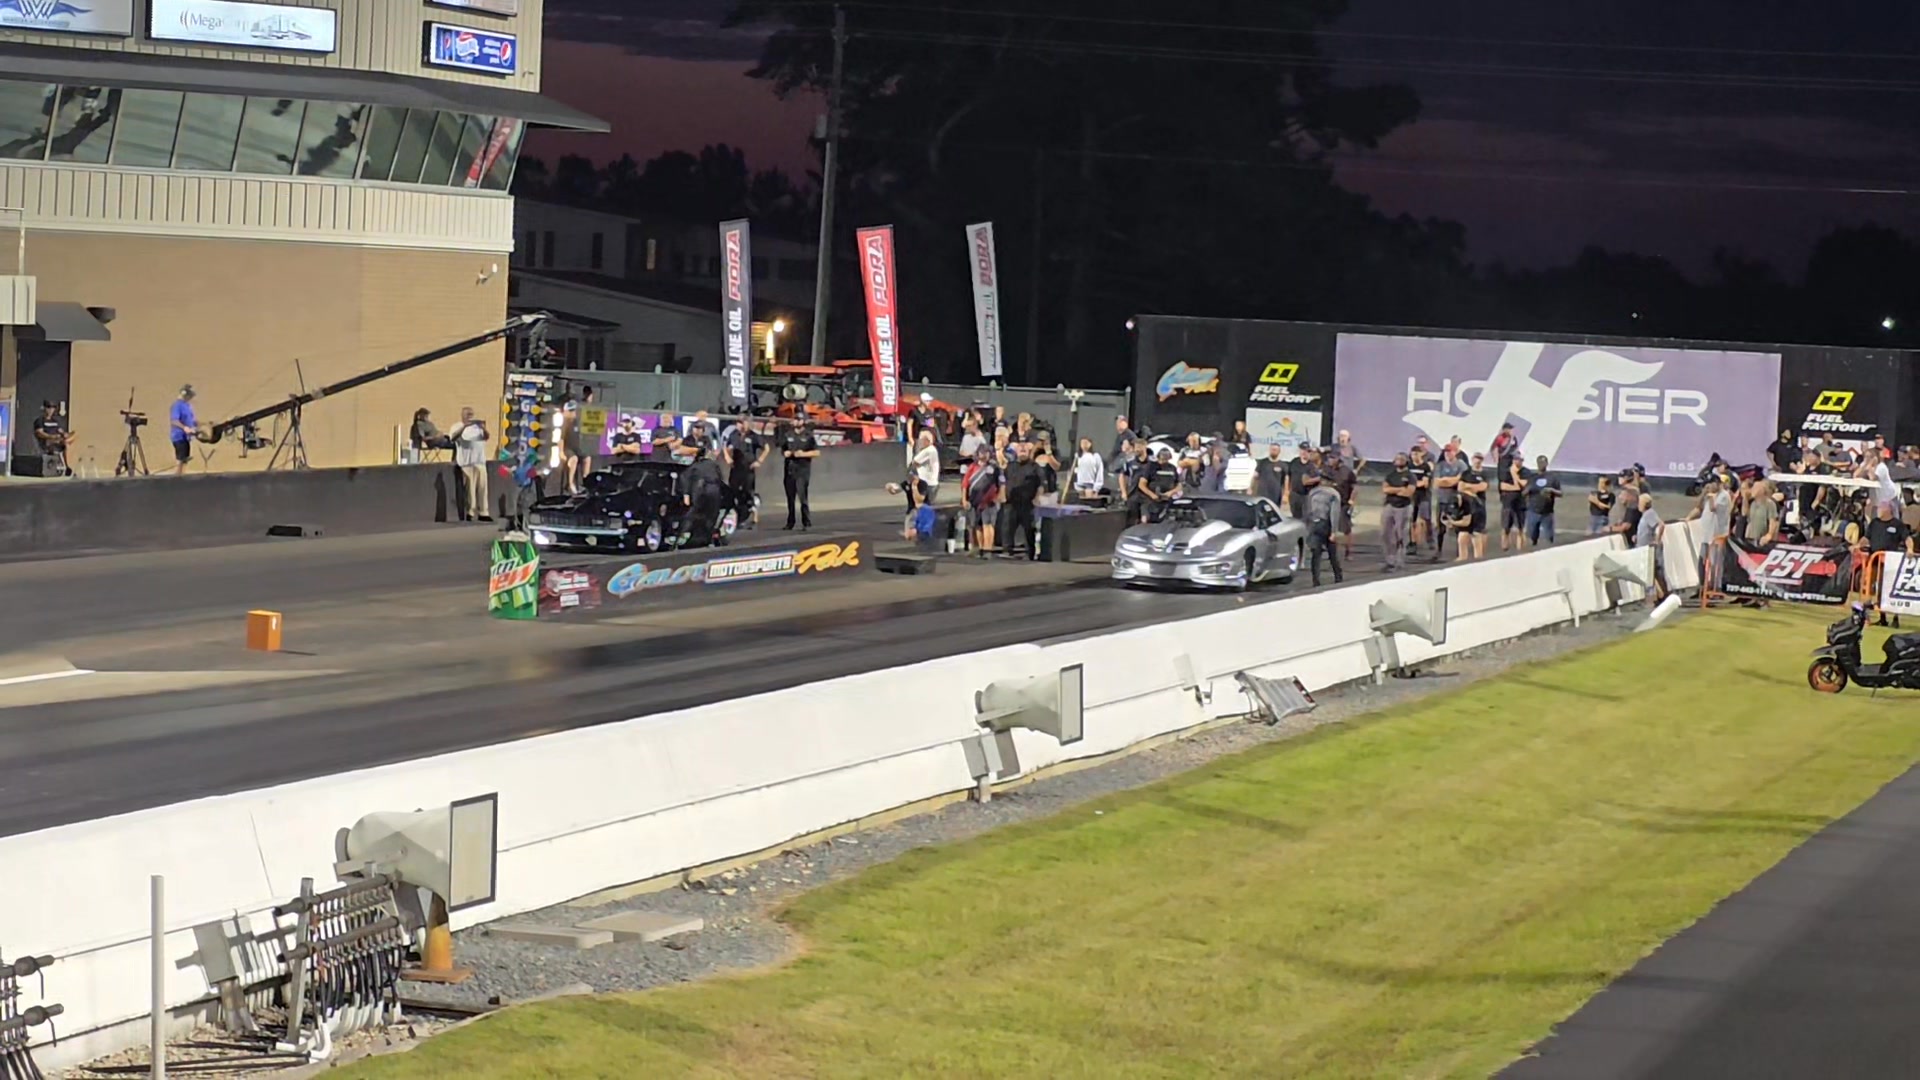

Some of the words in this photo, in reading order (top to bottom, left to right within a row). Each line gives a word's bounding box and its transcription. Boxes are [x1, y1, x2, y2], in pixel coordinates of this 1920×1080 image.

[728, 307, 742, 331] OIL
[875, 313, 892, 337] OIL
[729, 330, 743, 366] LINE
[878, 339, 895, 374] LINE
[729, 368, 746, 398] RED
[882, 376, 896, 406] RED
[1254, 385, 1291, 394] FUEL
[1249, 393, 1314, 404] FACTORY
[1801, 421, 1871, 433] FACTORY
[1806, 412, 1844, 423] FUEL
[709, 556, 793, 579] MOTORSPORTS
[1754, 549, 1824, 579] PST
